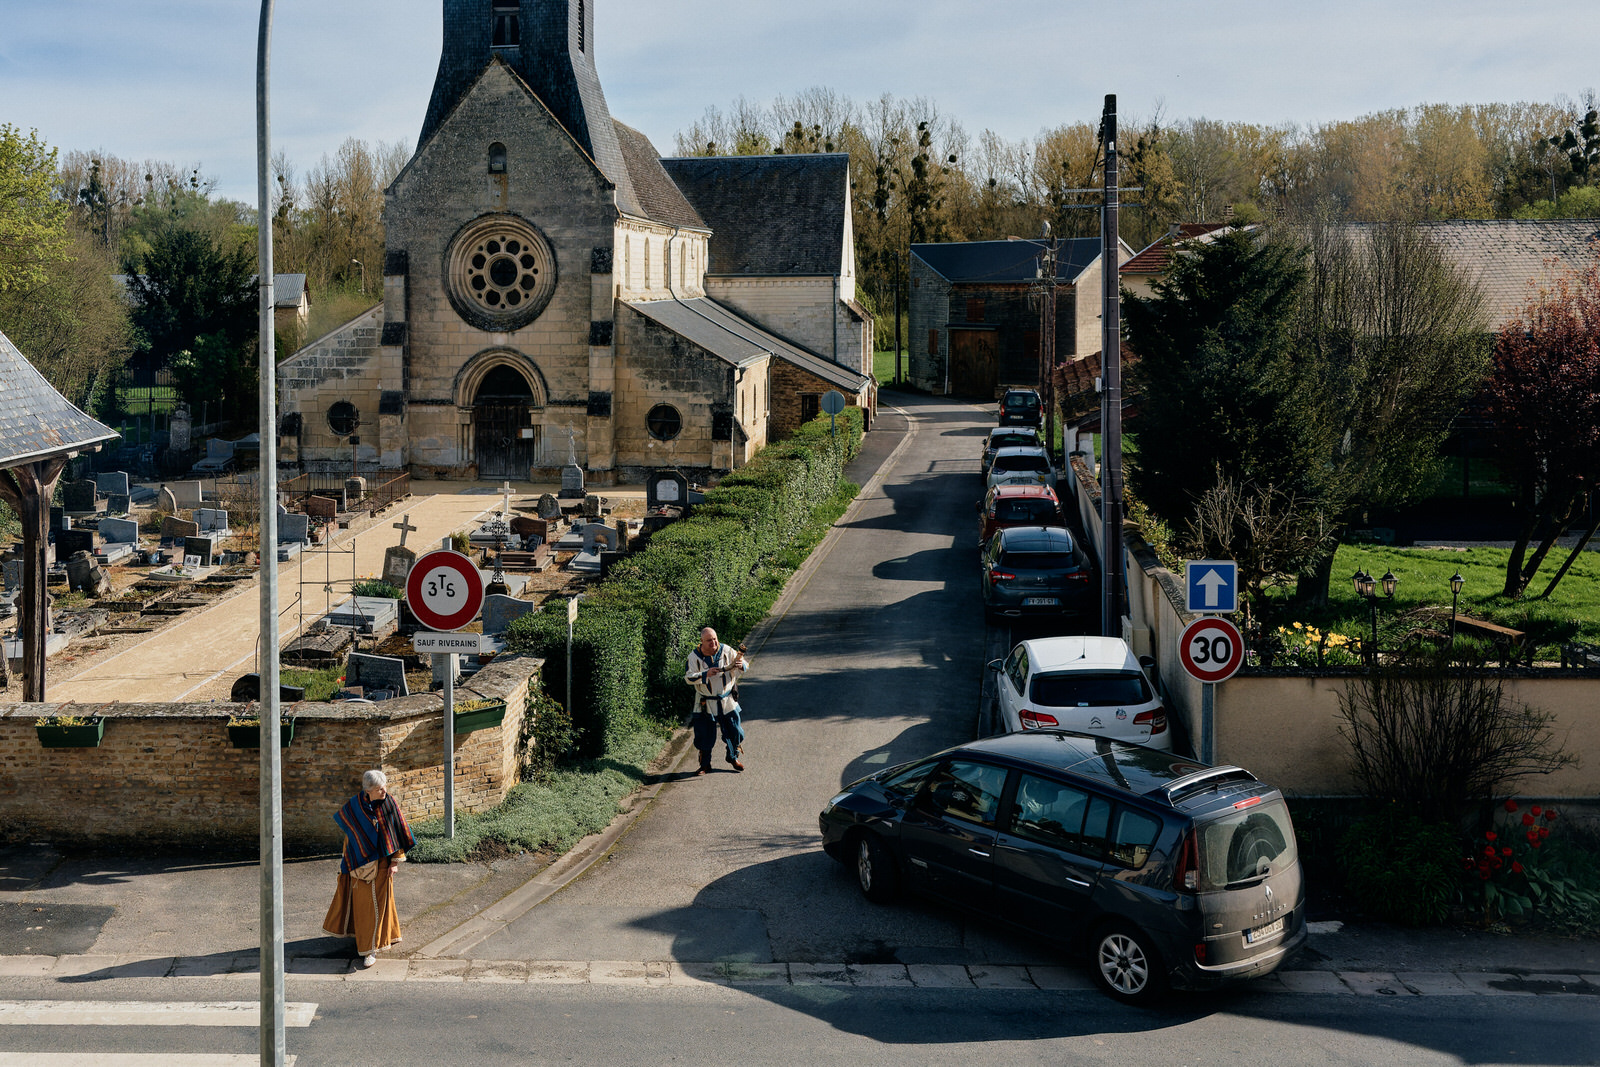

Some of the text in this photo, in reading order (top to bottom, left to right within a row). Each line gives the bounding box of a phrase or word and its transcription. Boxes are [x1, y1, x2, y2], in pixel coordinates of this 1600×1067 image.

[417, 639, 477, 648] SAUF RIVERAINS
[1192, 636, 1231, 664] 30
